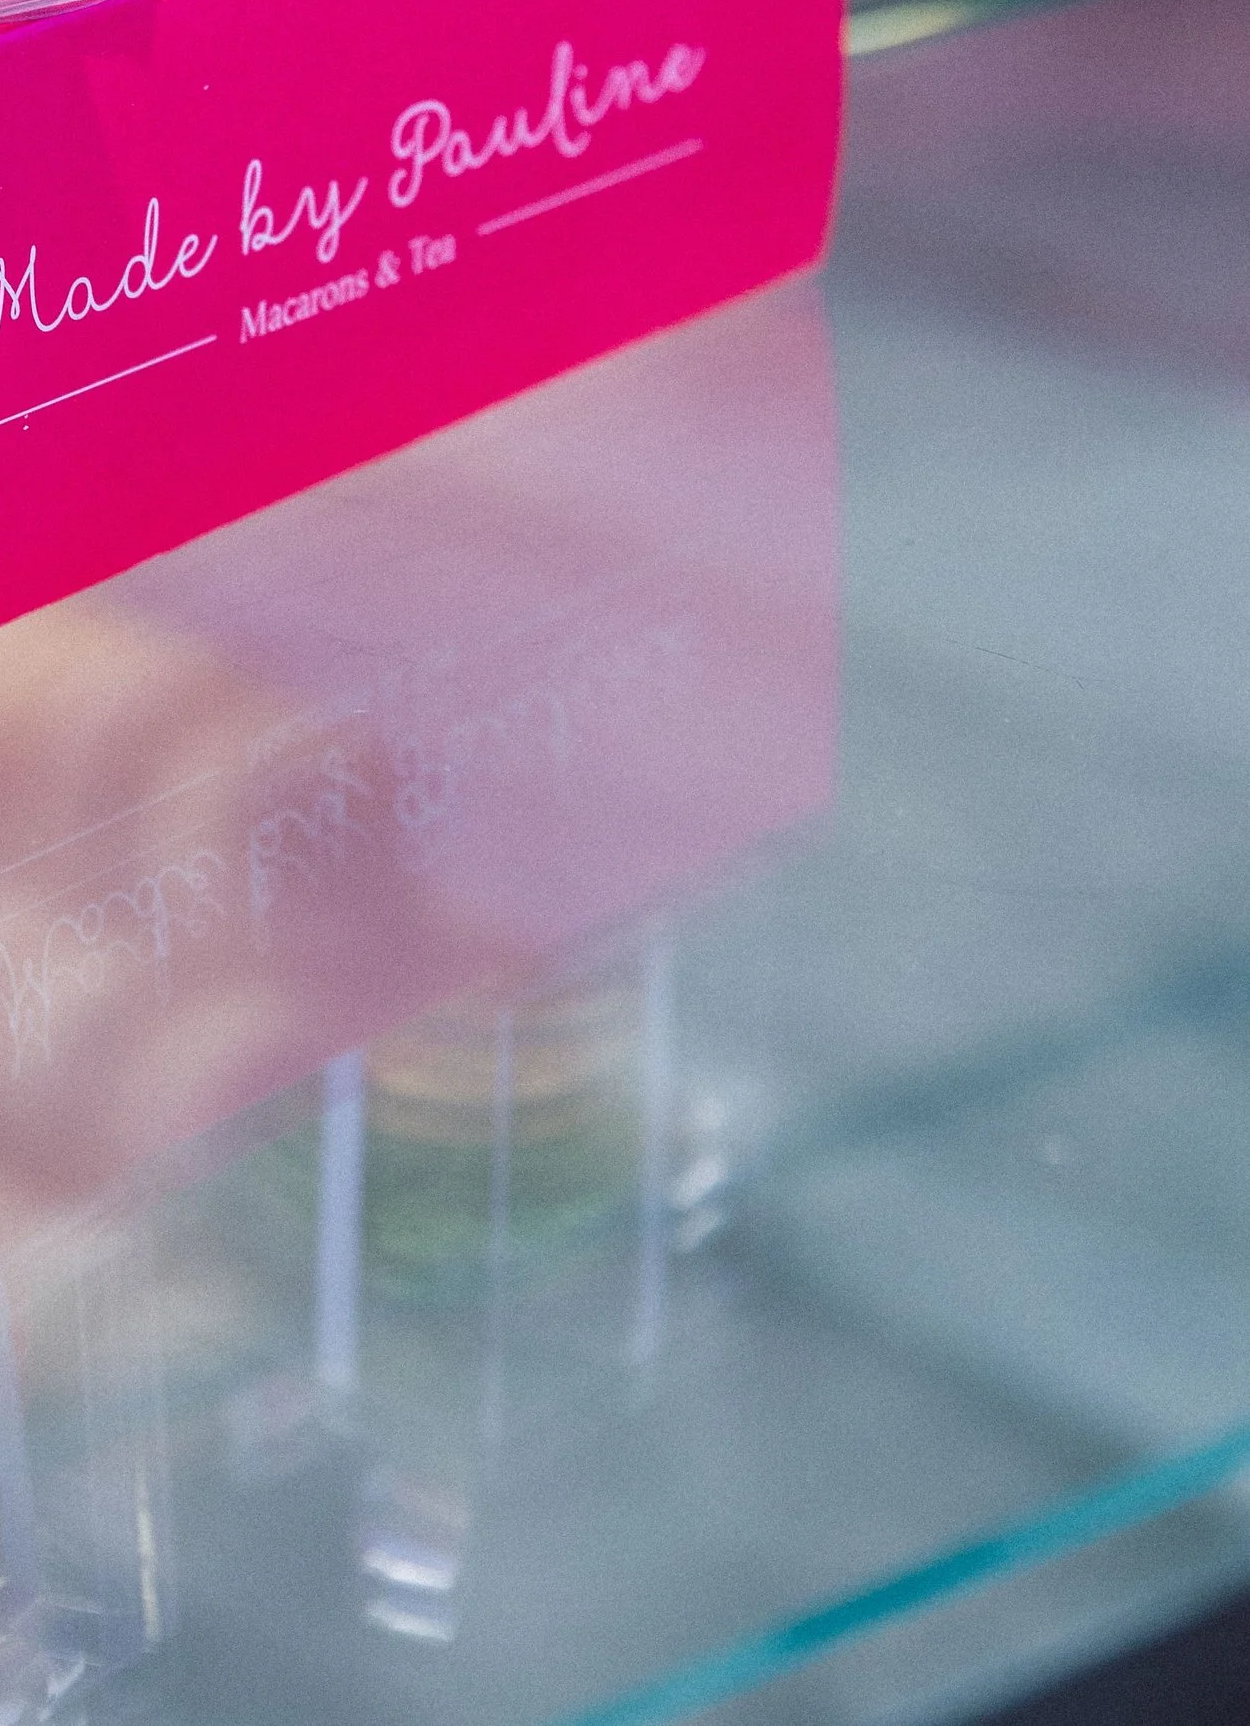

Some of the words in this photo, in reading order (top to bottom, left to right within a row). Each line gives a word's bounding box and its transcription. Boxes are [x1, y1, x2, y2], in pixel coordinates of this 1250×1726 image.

[239, 159, 367, 263] by
[388, 41, 705, 208] Pauline
[240, 267, 369, 344] Macarons
[374, 249, 401, 288] &
[409, 233, 457, 275] Tea
